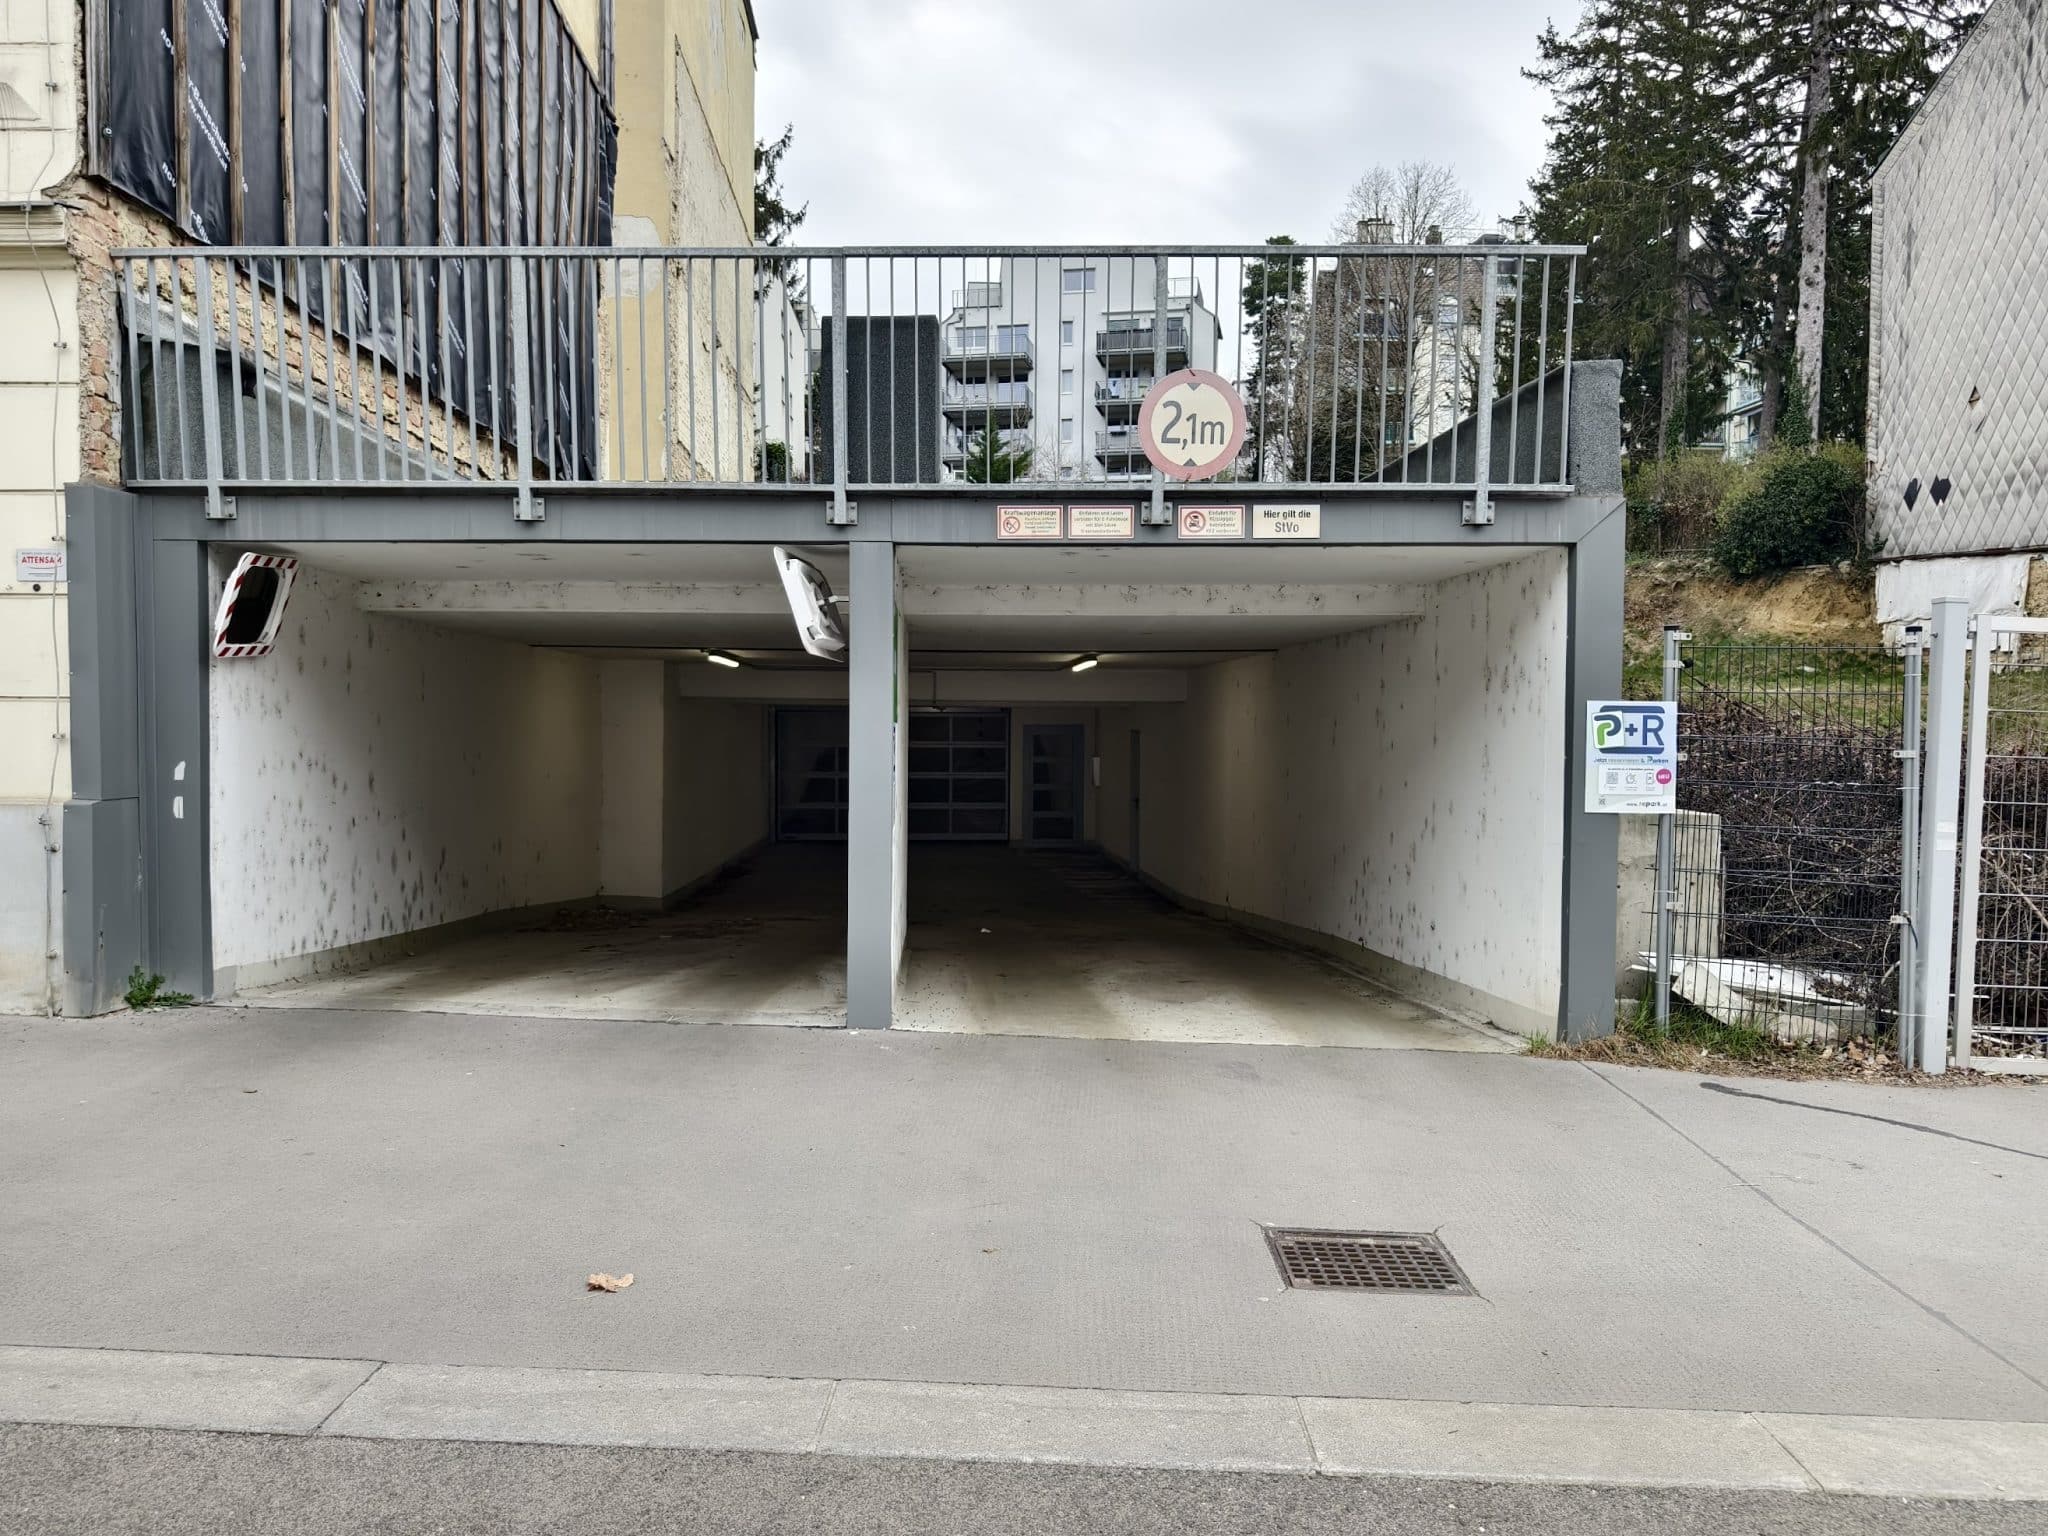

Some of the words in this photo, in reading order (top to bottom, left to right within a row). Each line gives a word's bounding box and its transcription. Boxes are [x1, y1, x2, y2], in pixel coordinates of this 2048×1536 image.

[1161, 400, 1225, 450] 2,1m
[1263, 509, 1280, 519] Hier
[1282, 509, 1296, 521] gilt
[1298, 509, 1312, 519] die
[1274, 521, 1300, 533] StVo
